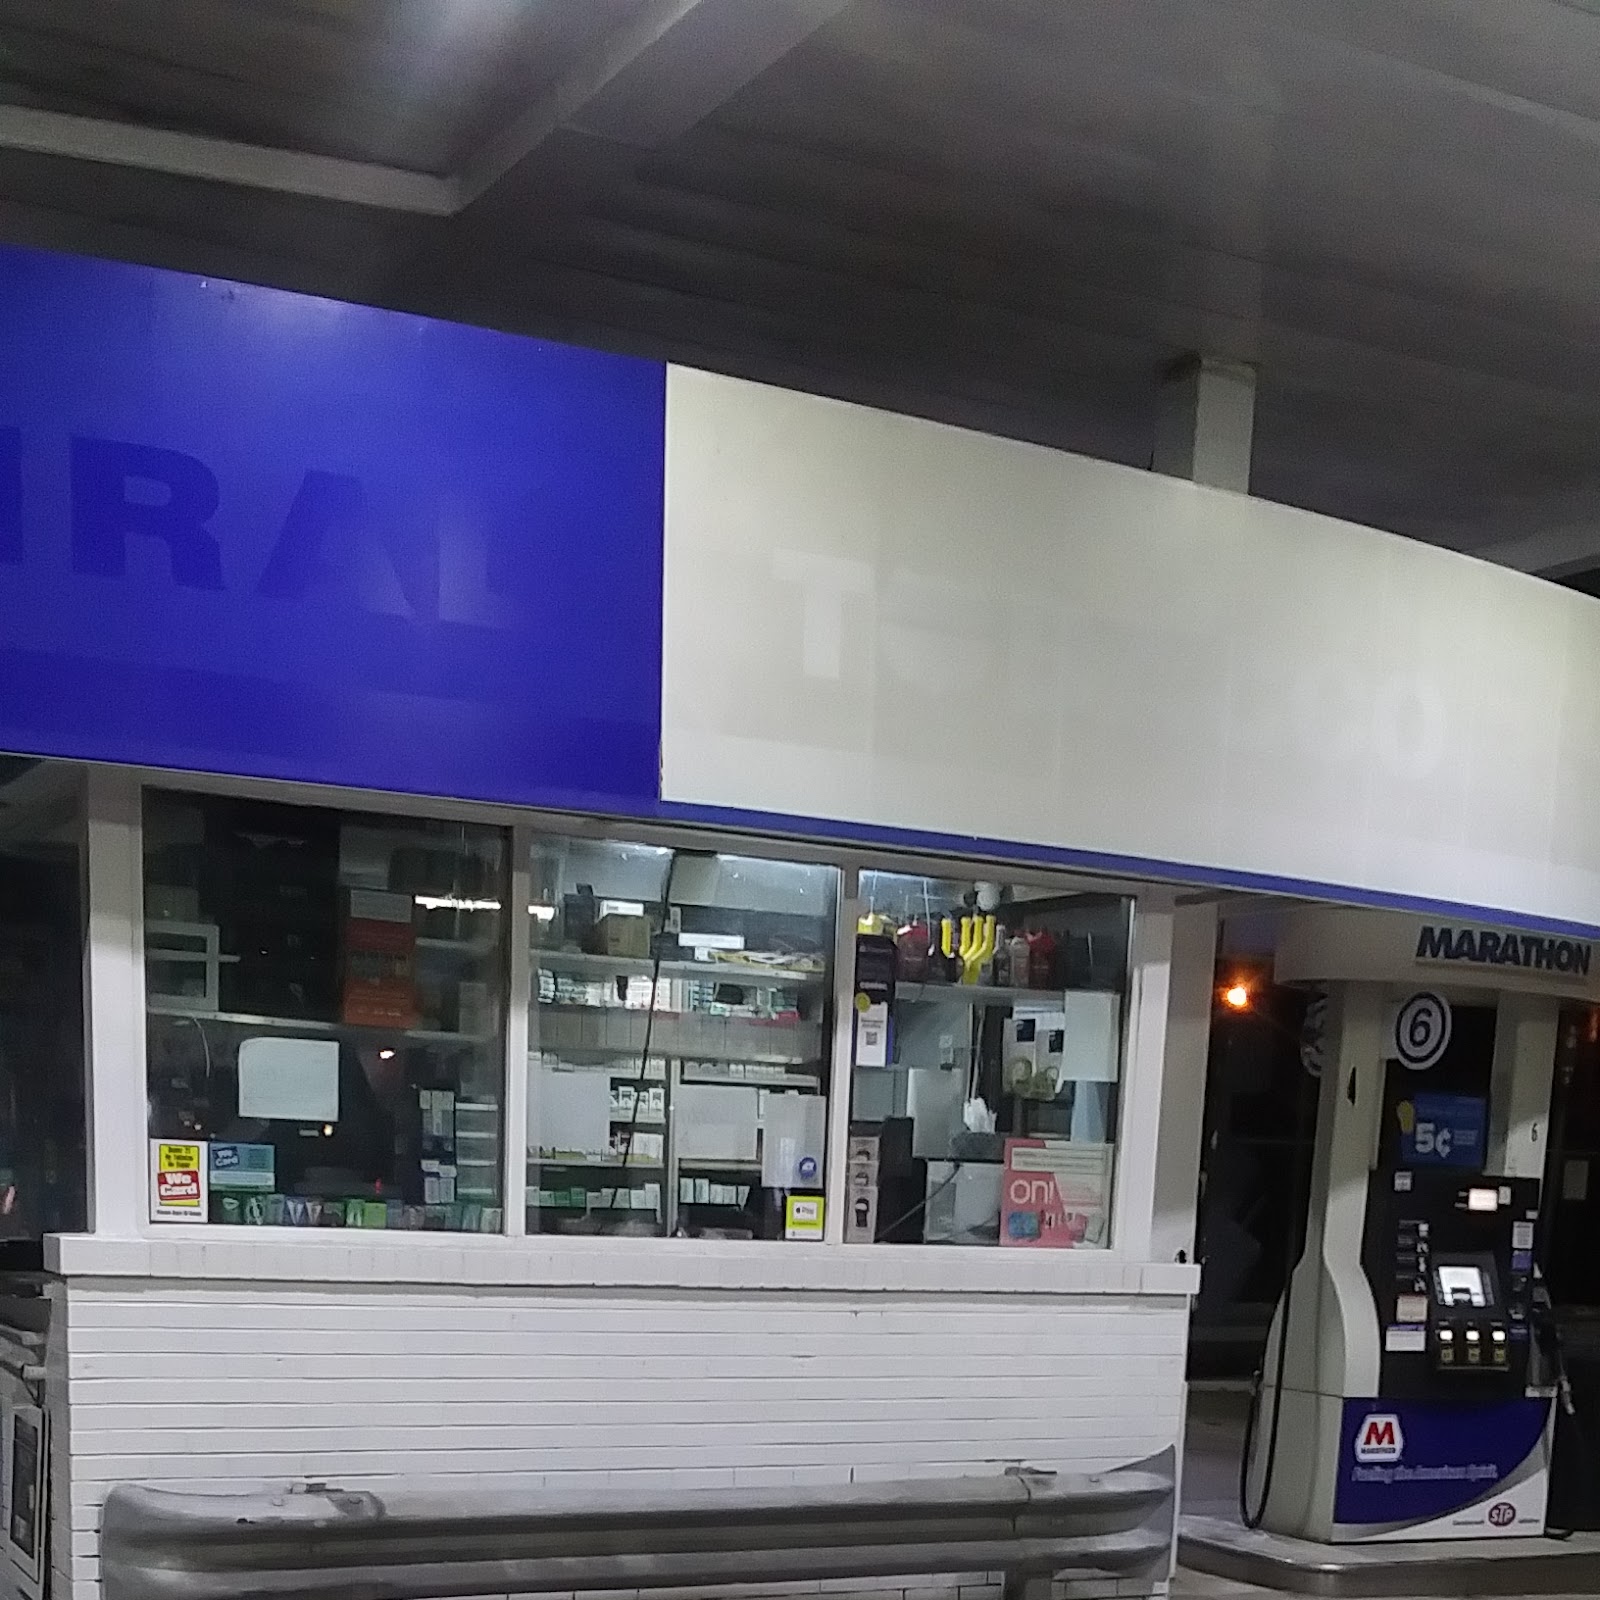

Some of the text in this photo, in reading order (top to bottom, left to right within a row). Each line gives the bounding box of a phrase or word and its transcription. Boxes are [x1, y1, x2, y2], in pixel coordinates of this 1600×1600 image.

[1415, 926, 1592, 975] MARATHON
[1409, 1008, 1433, 1048] 6
[1531, 1123, 1538, 1142] 6
[1364, 1422, 1395, 1446] M
[1490, 1504, 1514, 1523] STP
